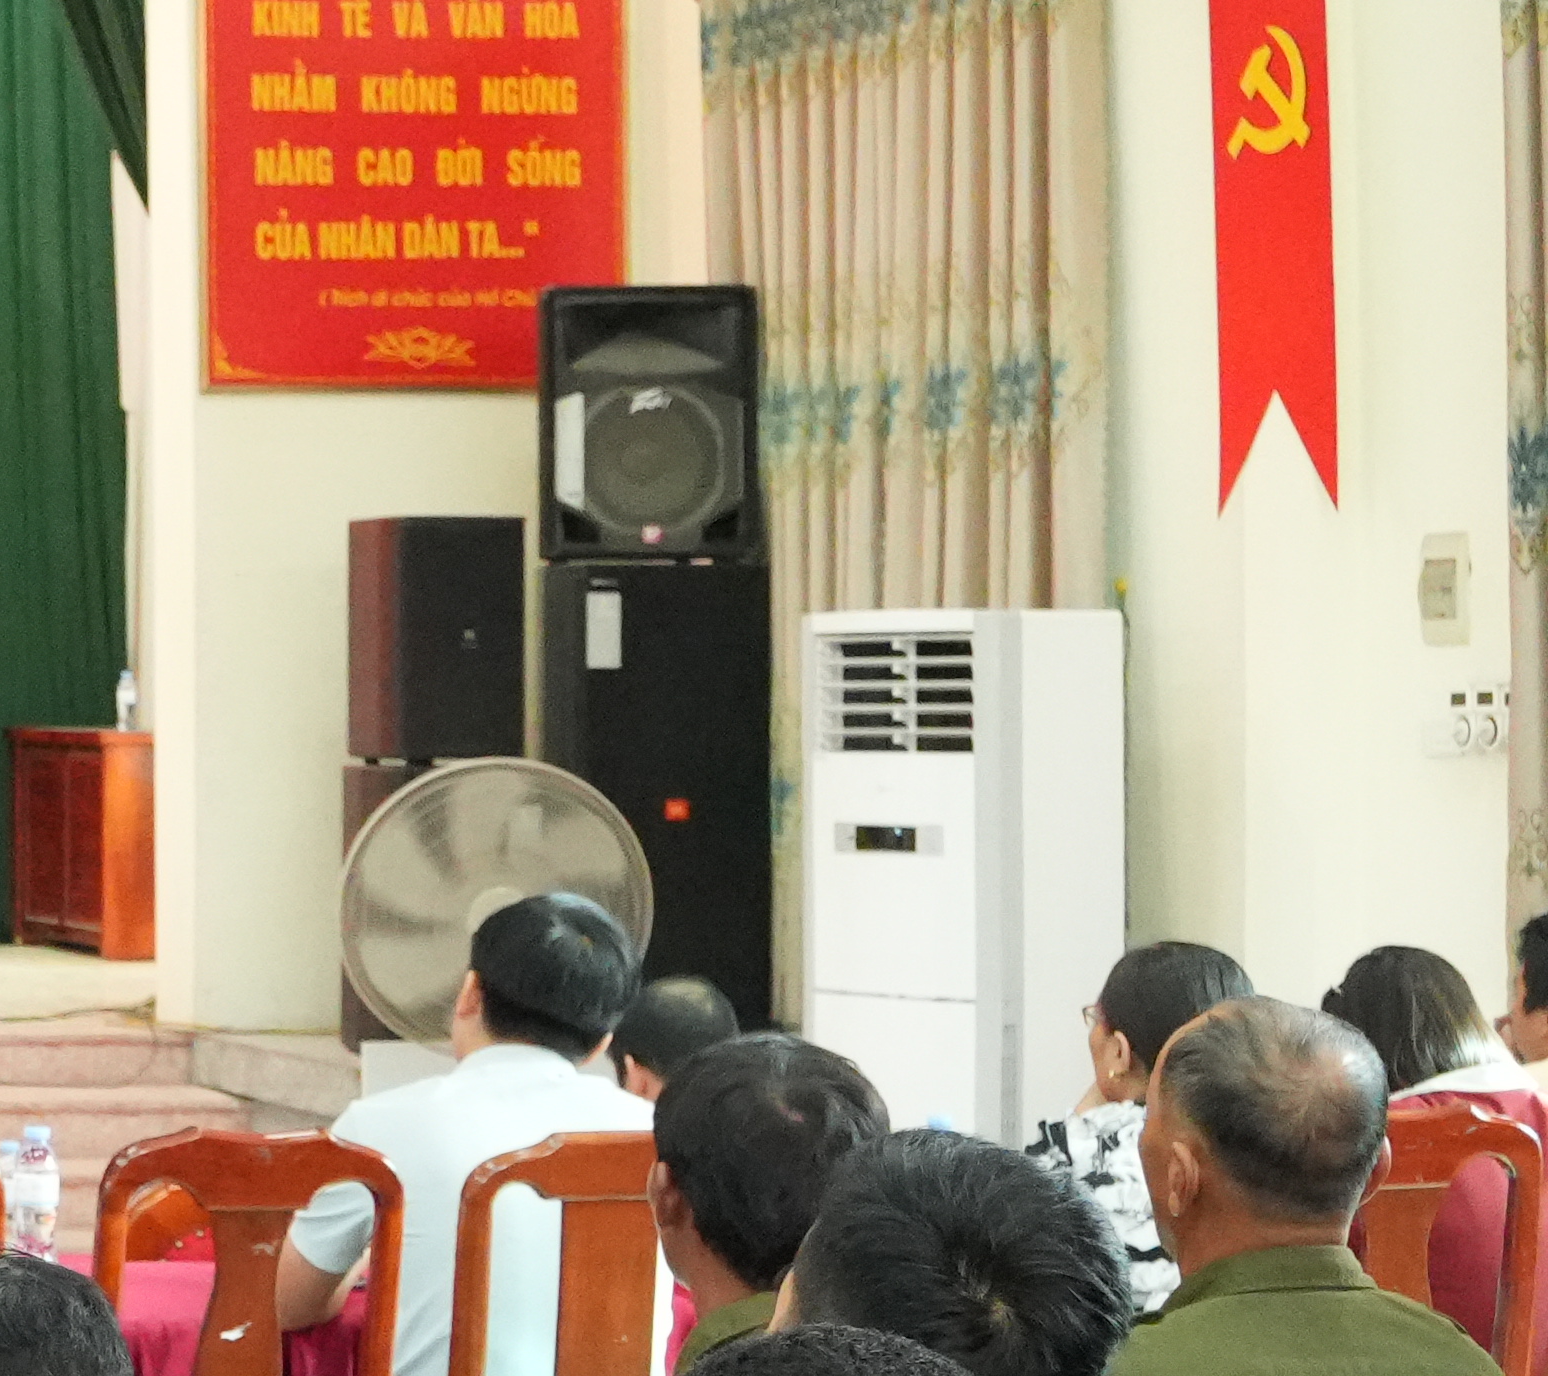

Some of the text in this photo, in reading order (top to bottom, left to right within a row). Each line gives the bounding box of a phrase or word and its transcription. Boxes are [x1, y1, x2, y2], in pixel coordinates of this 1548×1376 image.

[253, 0, 319, 37] KINH
[361, 69, 456, 114] KHÔNG
[255, 141, 333, 185] NÂNG
[358, 148, 412, 185] CAO
[256, 209, 459, 259] CỦA NHÂN DÂN
